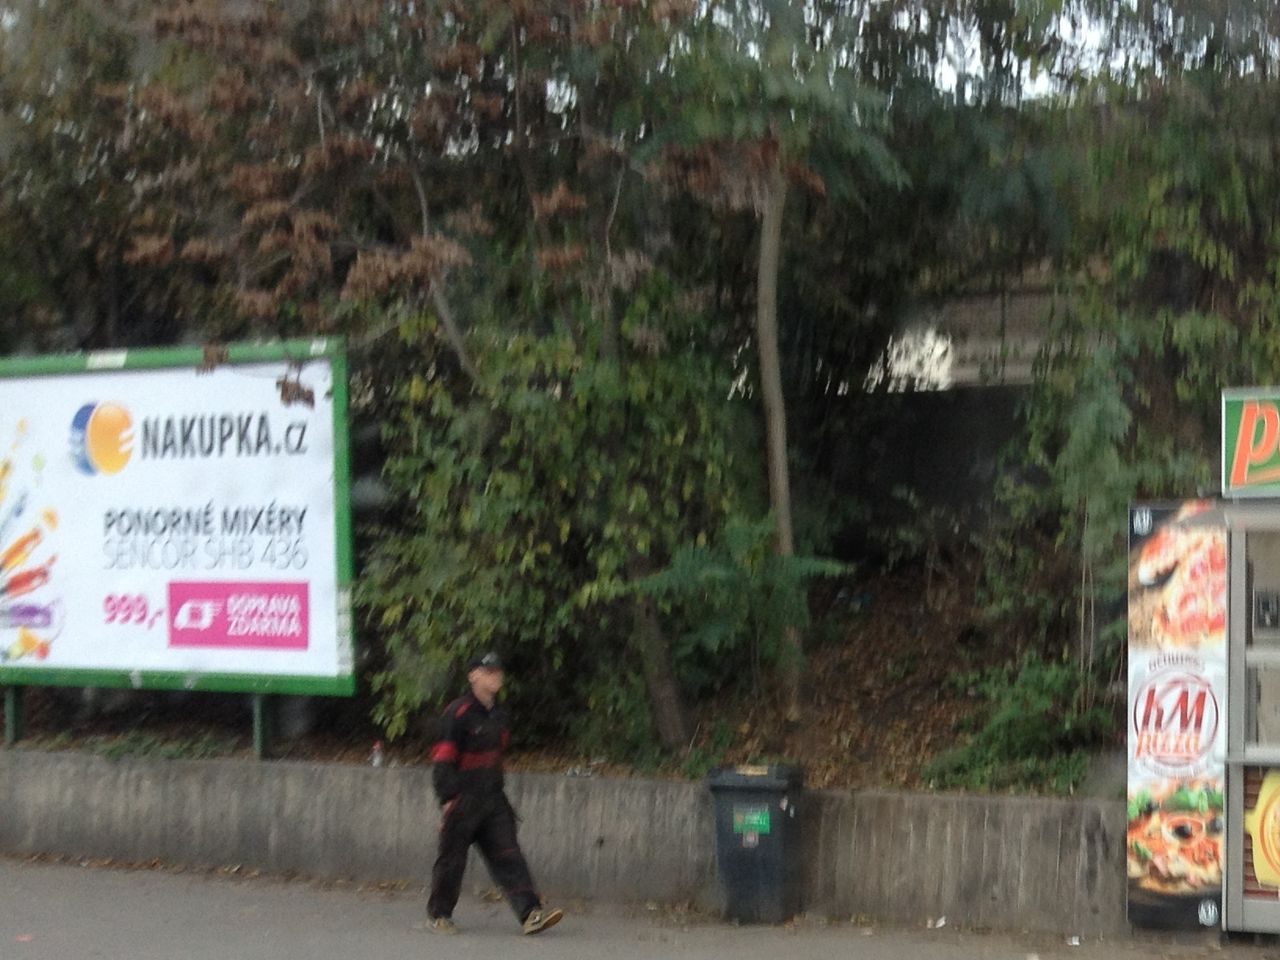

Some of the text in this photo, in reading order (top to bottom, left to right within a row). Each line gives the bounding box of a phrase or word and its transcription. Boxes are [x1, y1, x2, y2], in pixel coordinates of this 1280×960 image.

[103, 498, 308, 537] PONORNÉ MIXÉRY
[103, 536, 197, 570] SENCOR
[204, 536, 254, 570] SHB
